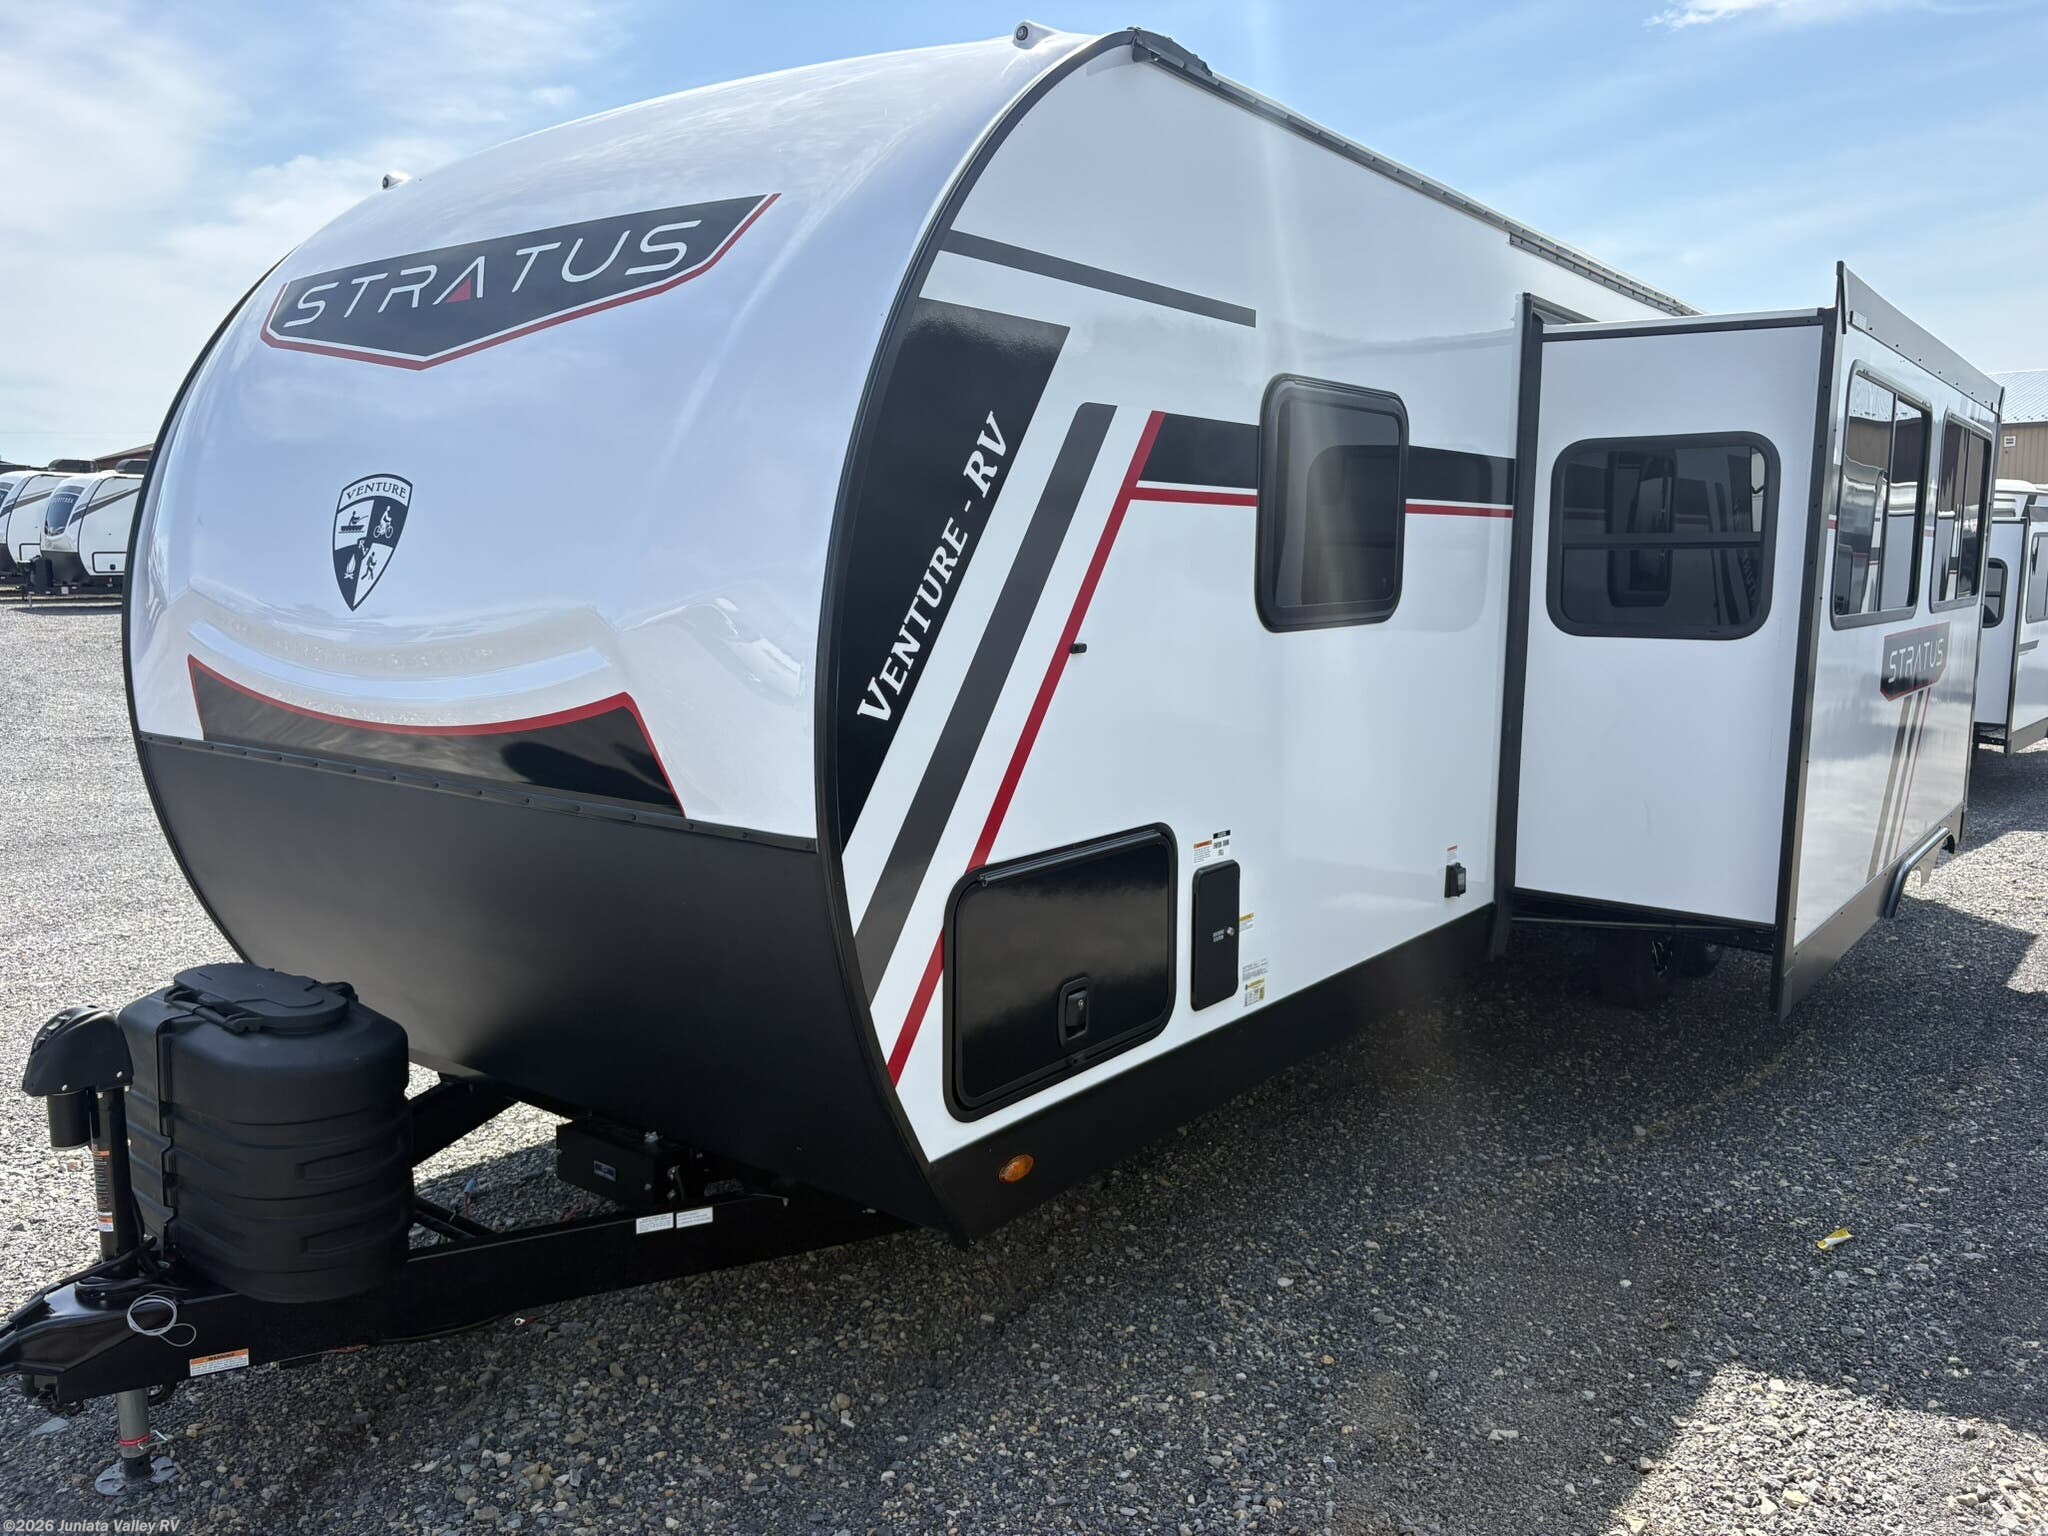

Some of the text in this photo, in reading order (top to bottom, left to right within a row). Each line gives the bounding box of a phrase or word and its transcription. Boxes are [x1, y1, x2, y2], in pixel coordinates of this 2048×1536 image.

[283, 219, 702, 328] STRATUS
[346, 481, 407, 501] VENTURE
[857, 517, 968, 722] VENTURE
[963, 410, 1007, 498] RV
[1887, 638, 1945, 684] STRATUS
